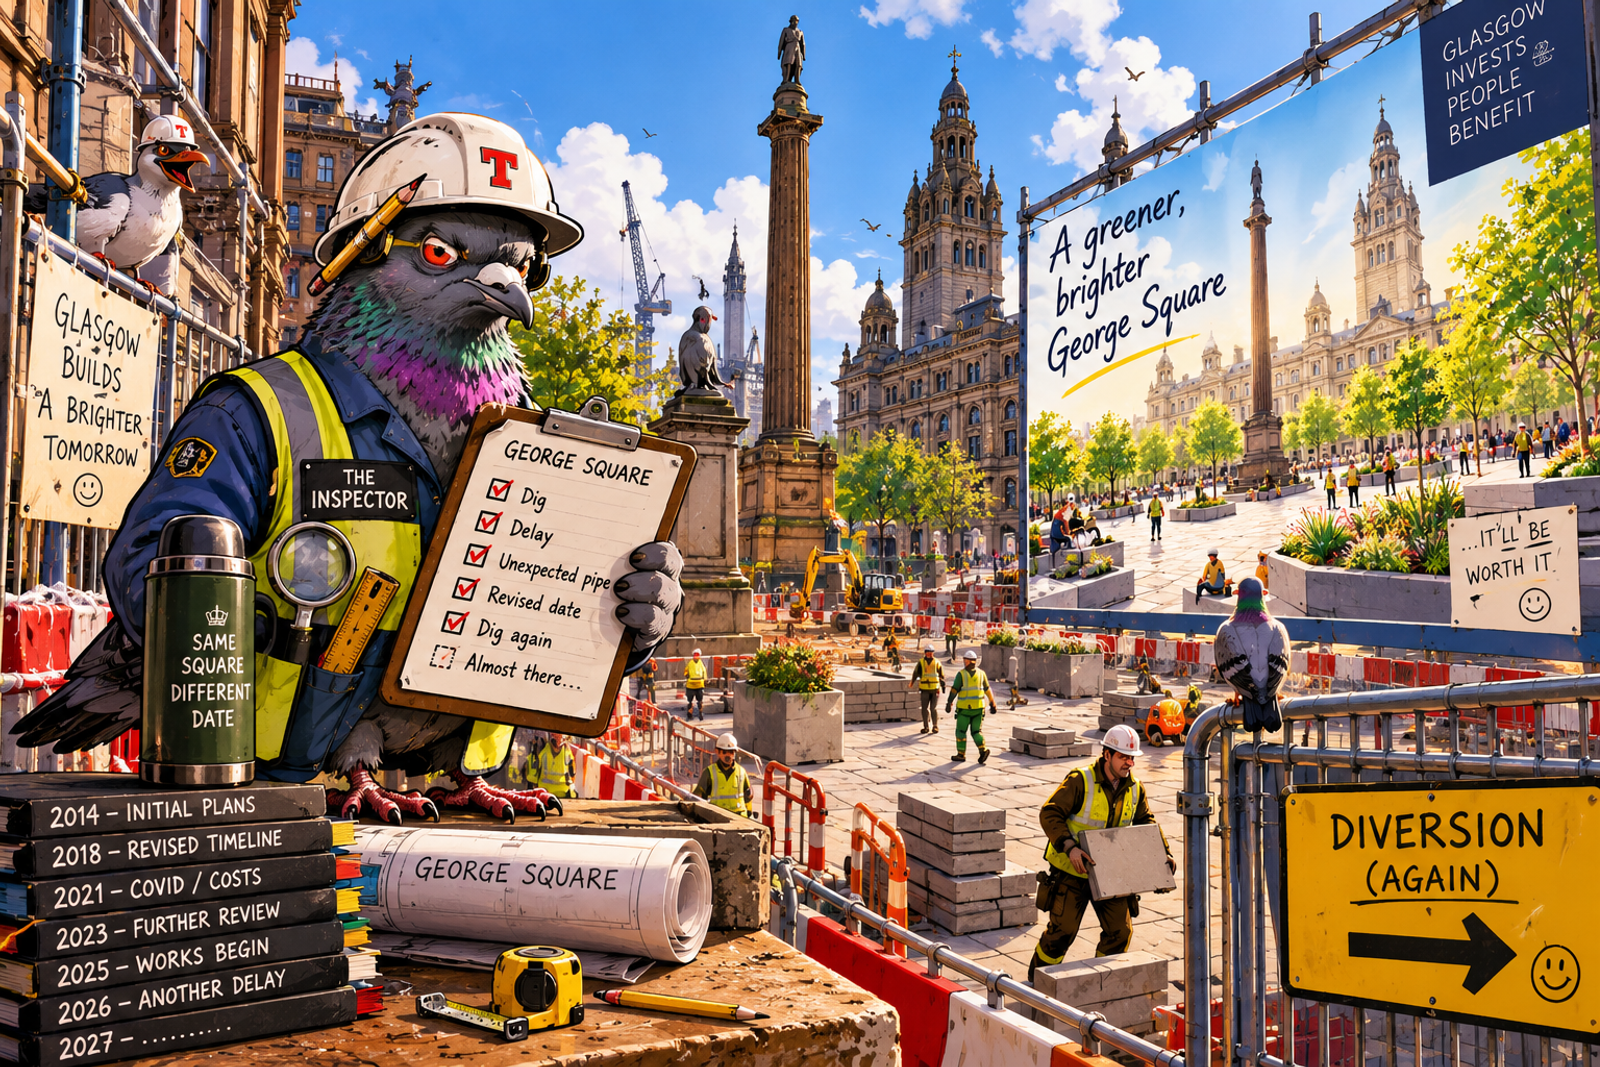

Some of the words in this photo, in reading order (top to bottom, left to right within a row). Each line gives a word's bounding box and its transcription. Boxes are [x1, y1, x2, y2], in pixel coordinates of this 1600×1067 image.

[1443, 0, 1544, 62] GLASGOW
[1446, 35, 1527, 90] INVESTS
[1448, 67, 1522, 117] PEOPLE
[175, 124, 187, 138] T
[1450, 90, 1535, 146] BENEFIT
[480, 146, 518, 190] T
[1049, 224, 1072, 273] A
[1082, 189, 1185, 270] greener,
[1056, 252, 1150, 319] brighter
[55, 292, 141, 357] GLASGOW
[1048, 314, 1132, 378] George
[1141, 273, 1227, 337] Square
[61, 345, 122, 393] BUILDS
[38, 388, 52, 421] A
[67, 395, 143, 436] BRIGHTER
[43, 435, 138, 467] TOMORROW
[504, 440, 577, 470] GEORGE
[582, 457, 653, 486] SQUARE
[343, 469, 375, 485] THE
[312, 490, 408, 510] INSPECTOR
[520, 487, 547, 514] Dig
[509, 519, 553, 549] Delay
[1528, 519, 1551, 541] BE
[499, 553, 578, 583] Unexpected
[581, 571, 611, 593] pipe
[1466, 557, 1524, 585] WORTH
[487, 585, 543, 612] Revised
[549, 597, 581, 619] date
[192, 633, 236, 651] SAME
[477, 618, 504, 646] Dig
[510, 631, 552, 651] again
[181, 656, 244, 676] SQUARE
[464, 652, 518, 678] Almost
[523, 663, 582, 690] there...
[171, 683, 251, 702] DIFFERENT
[192, 708, 234, 728] DATE
[50, 803, 99, 829] 2014
[126, 801, 193, 822] INITIAL
[202, 796, 256, 816] PLANS
[1331, 808, 1543, 850] DIVERSION
[52, 842, 101, 868] 2018
[128, 835, 199, 860] REVISED
[206, 829, 283, 852] TIMELINE
[54, 882, 104, 909] 2021
[130, 875, 185, 899] COVID
[192, 871, 203, 895] /
[209, 867, 262, 890] COSTS
[415, 856, 510, 883] GEORGE
[522, 863, 619, 890] SQUARE
[1366, 859, 1499, 898] (AGAIN)
[56, 923, 108, 951] 2023
[133, 910, 210, 939] FURTHER
[219, 901, 281, 926] REVIEW
[57, 959, 110, 988] 2025
[135, 946, 204, 975] WORKS
[215, 937, 270, 963] BEGIN
[58, 995, 112, 1025] 2026
[138, 978, 224, 1010] ANOTHER
[232, 968, 286, 995] DELAY
[59, 1031, 113, 1061] 2027
